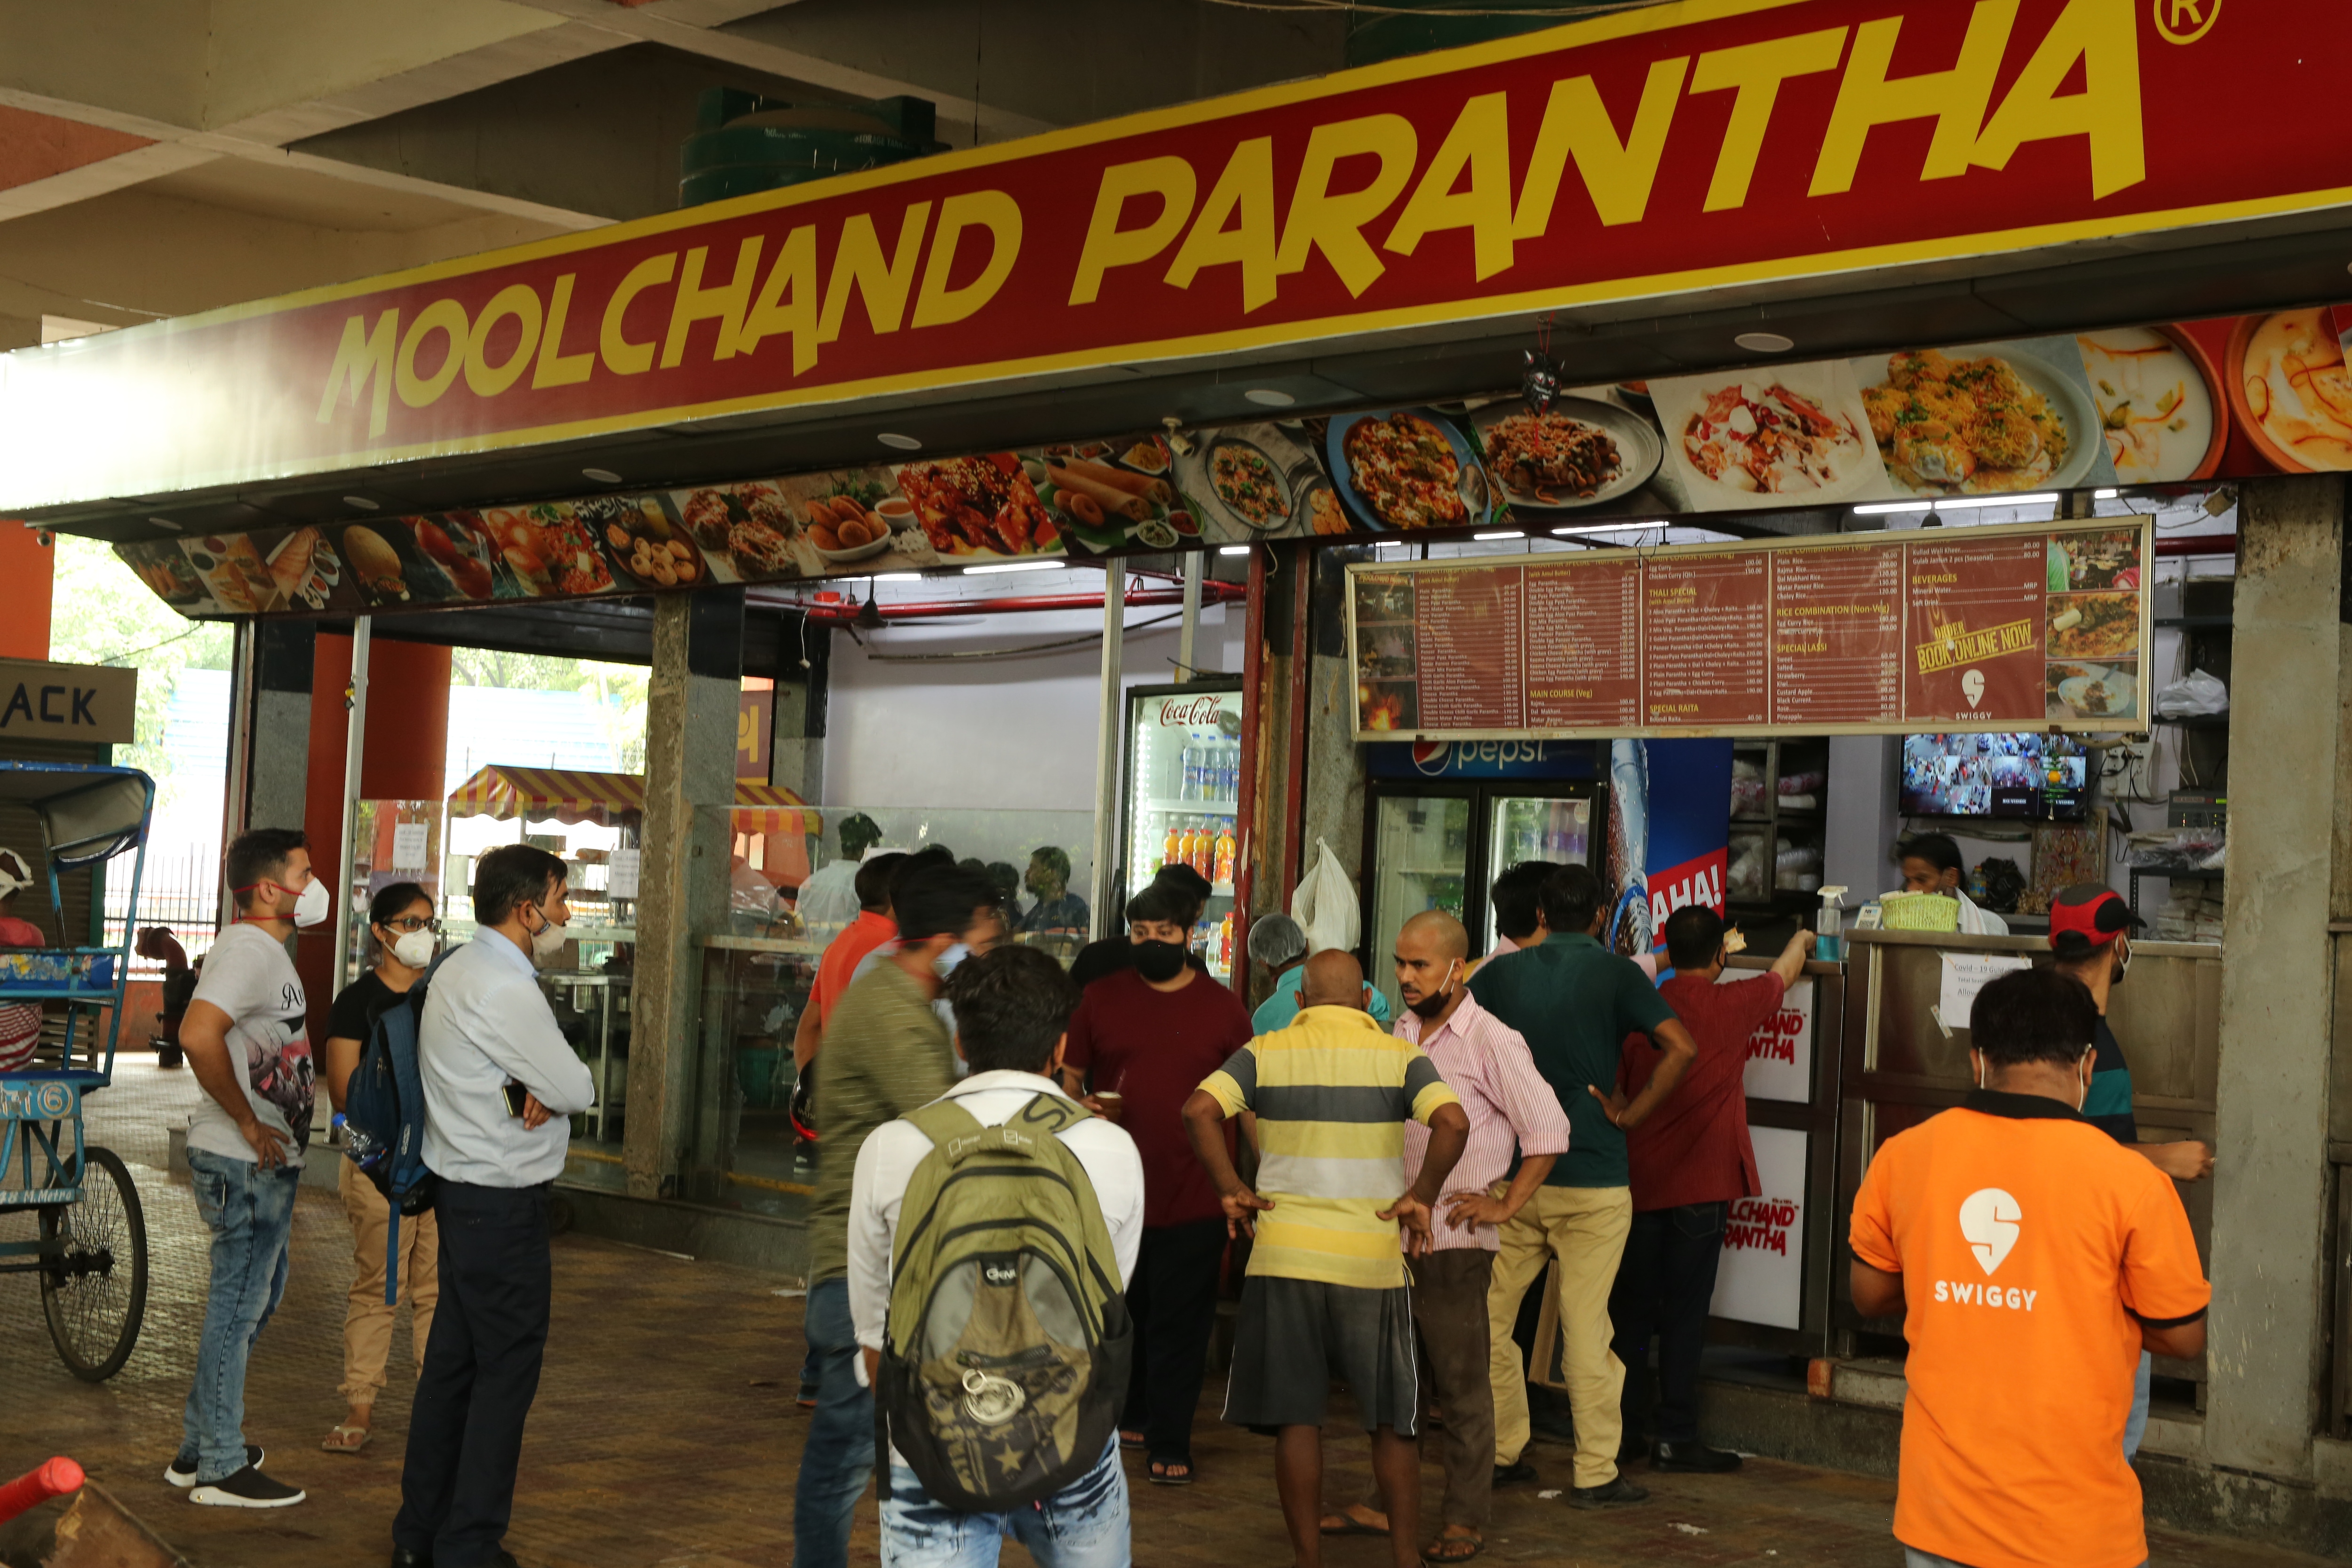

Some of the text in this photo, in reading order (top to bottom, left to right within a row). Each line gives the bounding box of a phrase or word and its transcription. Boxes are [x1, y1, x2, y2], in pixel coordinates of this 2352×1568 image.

[316, 191, 1022, 440] MOOLCHAND
[1069, 0, 2145, 313] PARANTHA
[1913, 547, 1930, 556] Kullad
[1931, 547, 1943, 555] Wali
[1930, 555, 1948, 564] Jamun
[1954, 556, 1963, 564] pcs
[1964, 553, 1994, 564] (Seasonal)
[1682, 570, 1696, 579] (Qtr.)
[1879, 569, 1897, 578] 120.00
[1912, 573, 1957, 584] BEVERAGES
[1649, 587, 1698, 598] THALI SPECIAL
[1912, 586, 1933, 595] Mineral
[2024, 581, 2038, 590] MRP
[1777, 592, 1795, 601] Choley
[1649, 598, 1662, 607] (with
[1777, 602, 1890, 617] RICE COMBINATION (Non-Veg)
[1935, 620, 1966, 640] ORDER
[1777, 643, 1827, 653] SPECIAL LASSI
[1917, 622, 2032, 670] BOOK ONLINE NOW
[1777, 672, 1805, 680] Strawberry
[1530, 688, 1593, 700] MAIN COURSE (Veg)
[1797, 688, 1813, 696] Apple
[1160, 695, 1223, 728] Coca-Cola
[1650, 703, 1699, 714] SPECIAL RAITA
[1777, 713, 1802, 722] Pineapple
[1955, 711, 1992, 721] SWIGGY
[1955, 963, 1972, 972] Covid
[1934, 1280, 2037, 1312] SWIGGY
